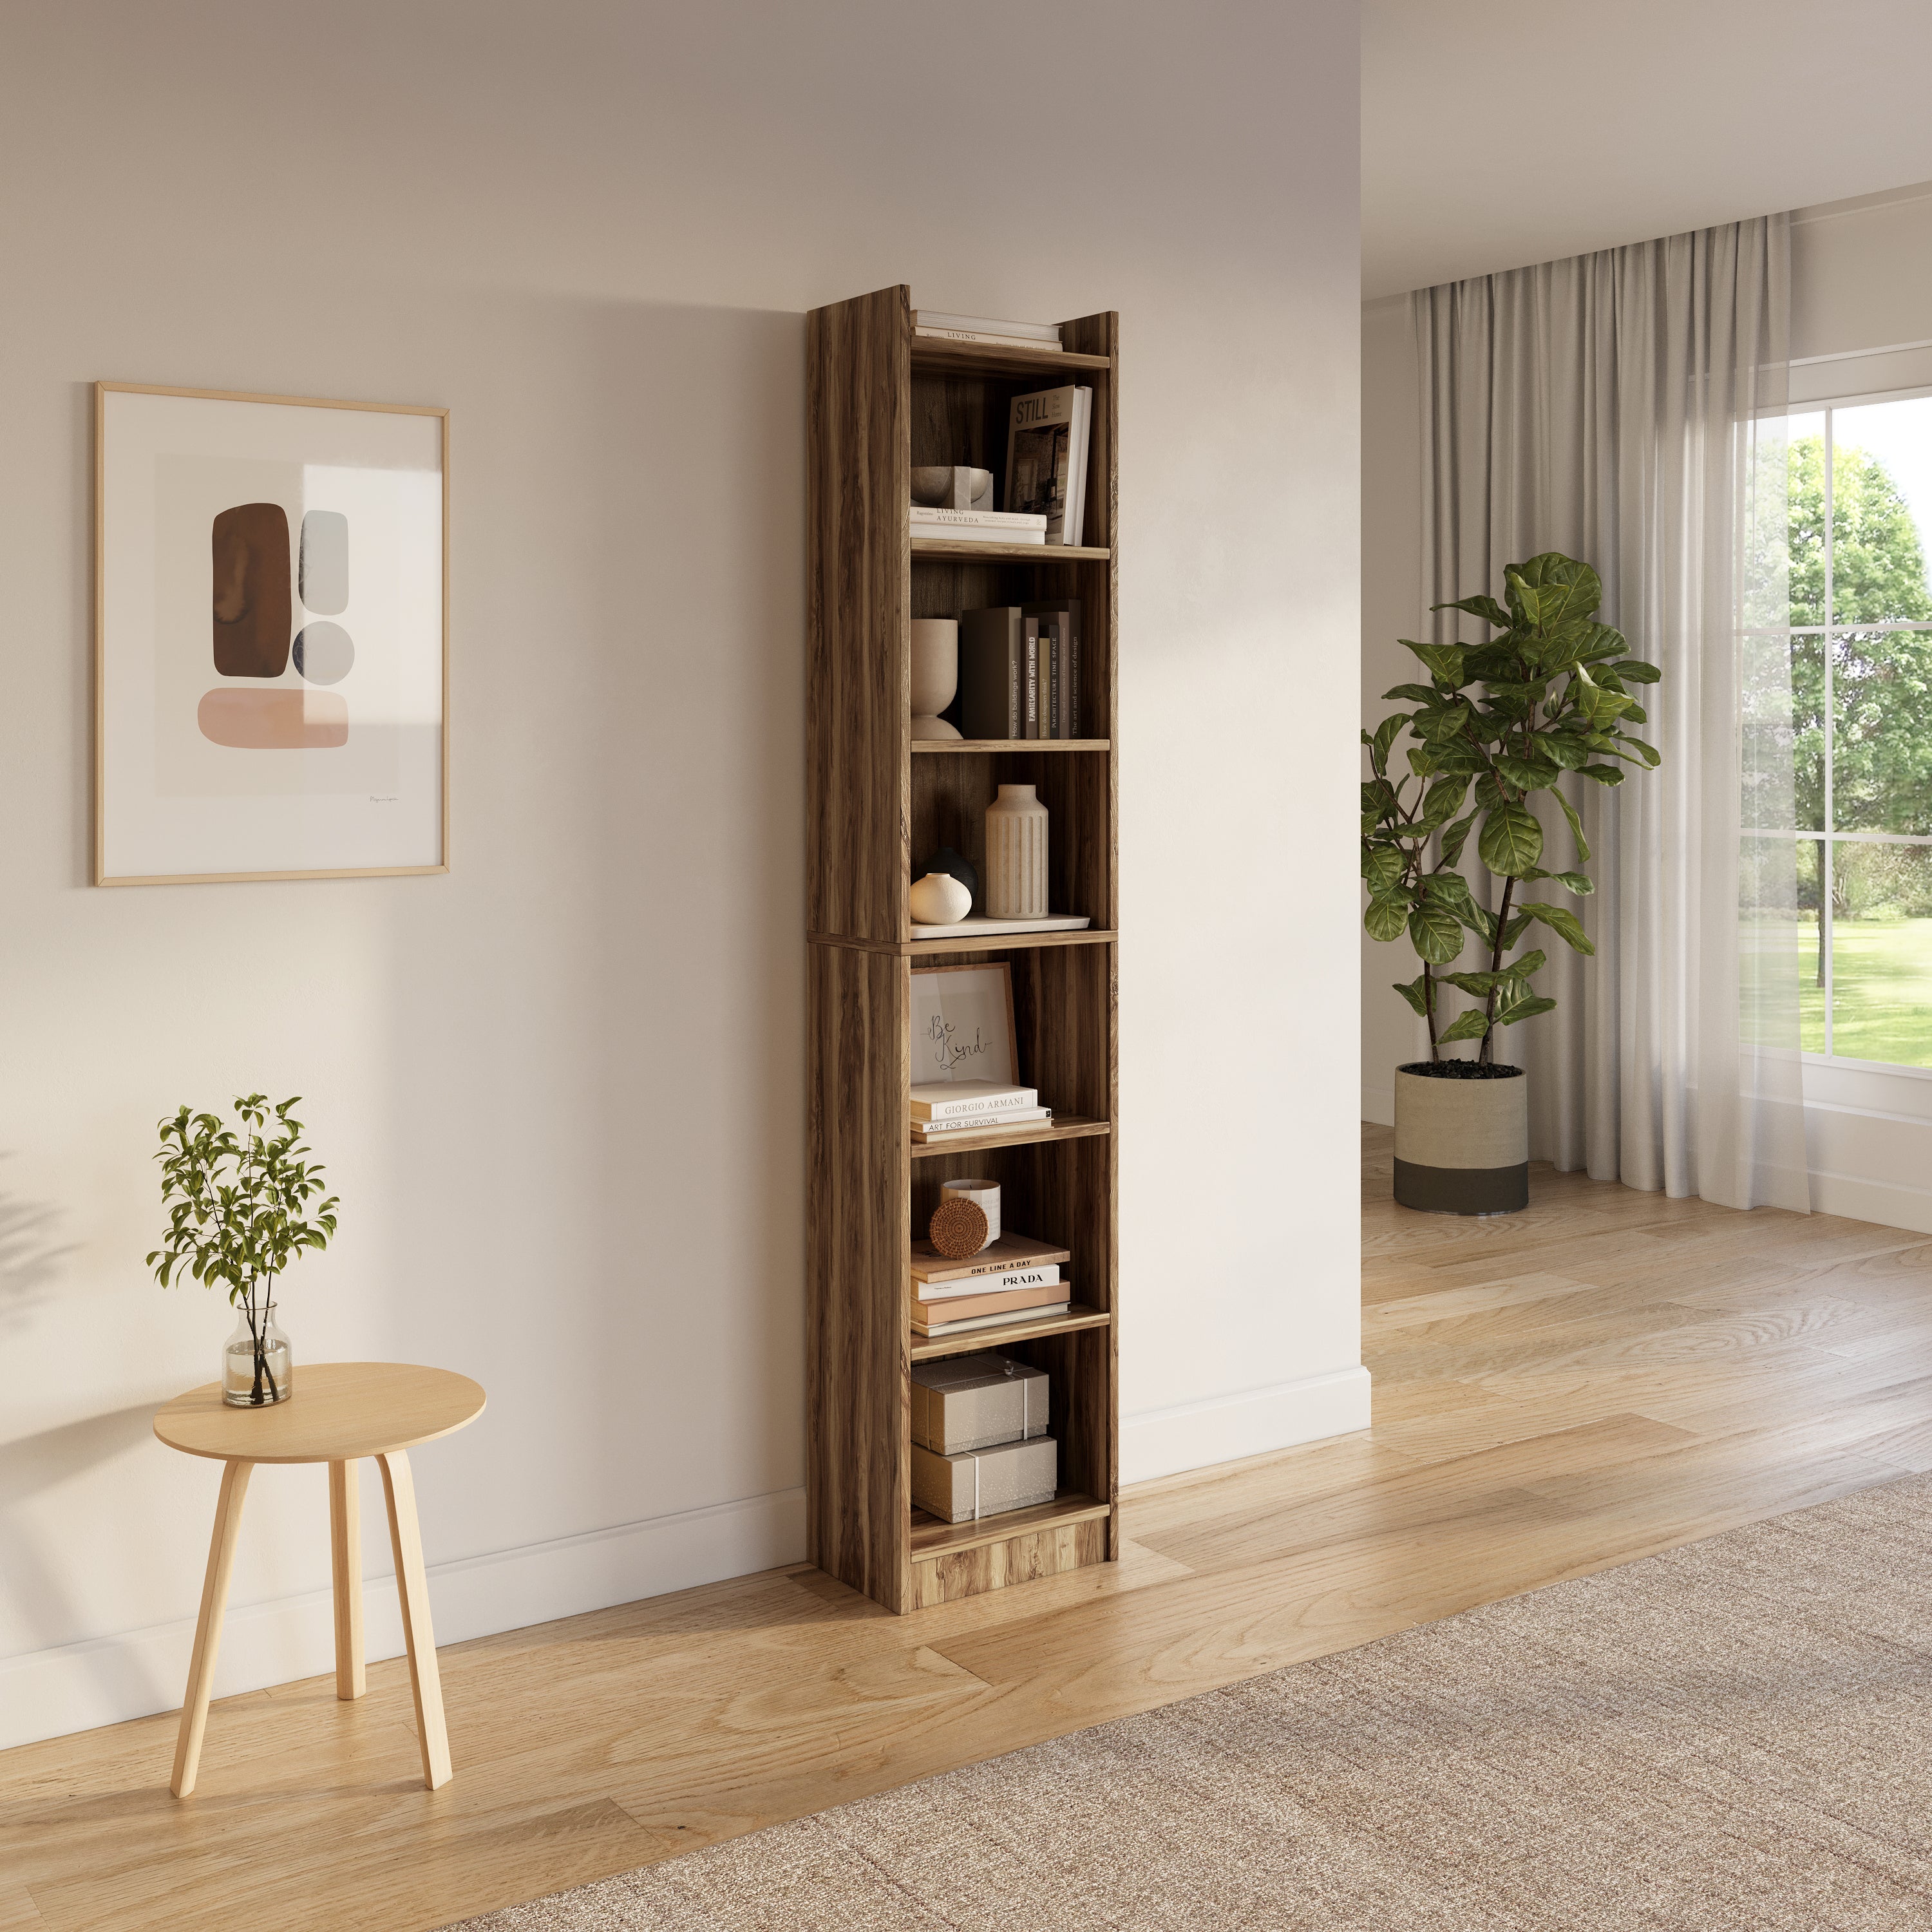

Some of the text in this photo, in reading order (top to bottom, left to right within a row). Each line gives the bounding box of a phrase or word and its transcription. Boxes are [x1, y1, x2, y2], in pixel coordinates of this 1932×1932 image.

[947, 332, 976, 340] LIVING
[1016, 397, 1048, 424] STILL
[1072, 659, 1077, 668] of
[920, 1016, 955, 1040] Be
[935, 1027, 992, 1070] Kind
[945, 1097, 1023, 1114] GIORGIO ARMANI
[964, 1117, 998, 1127] SURVIVAL
[1003, 1274, 1043, 1285] PRADA
